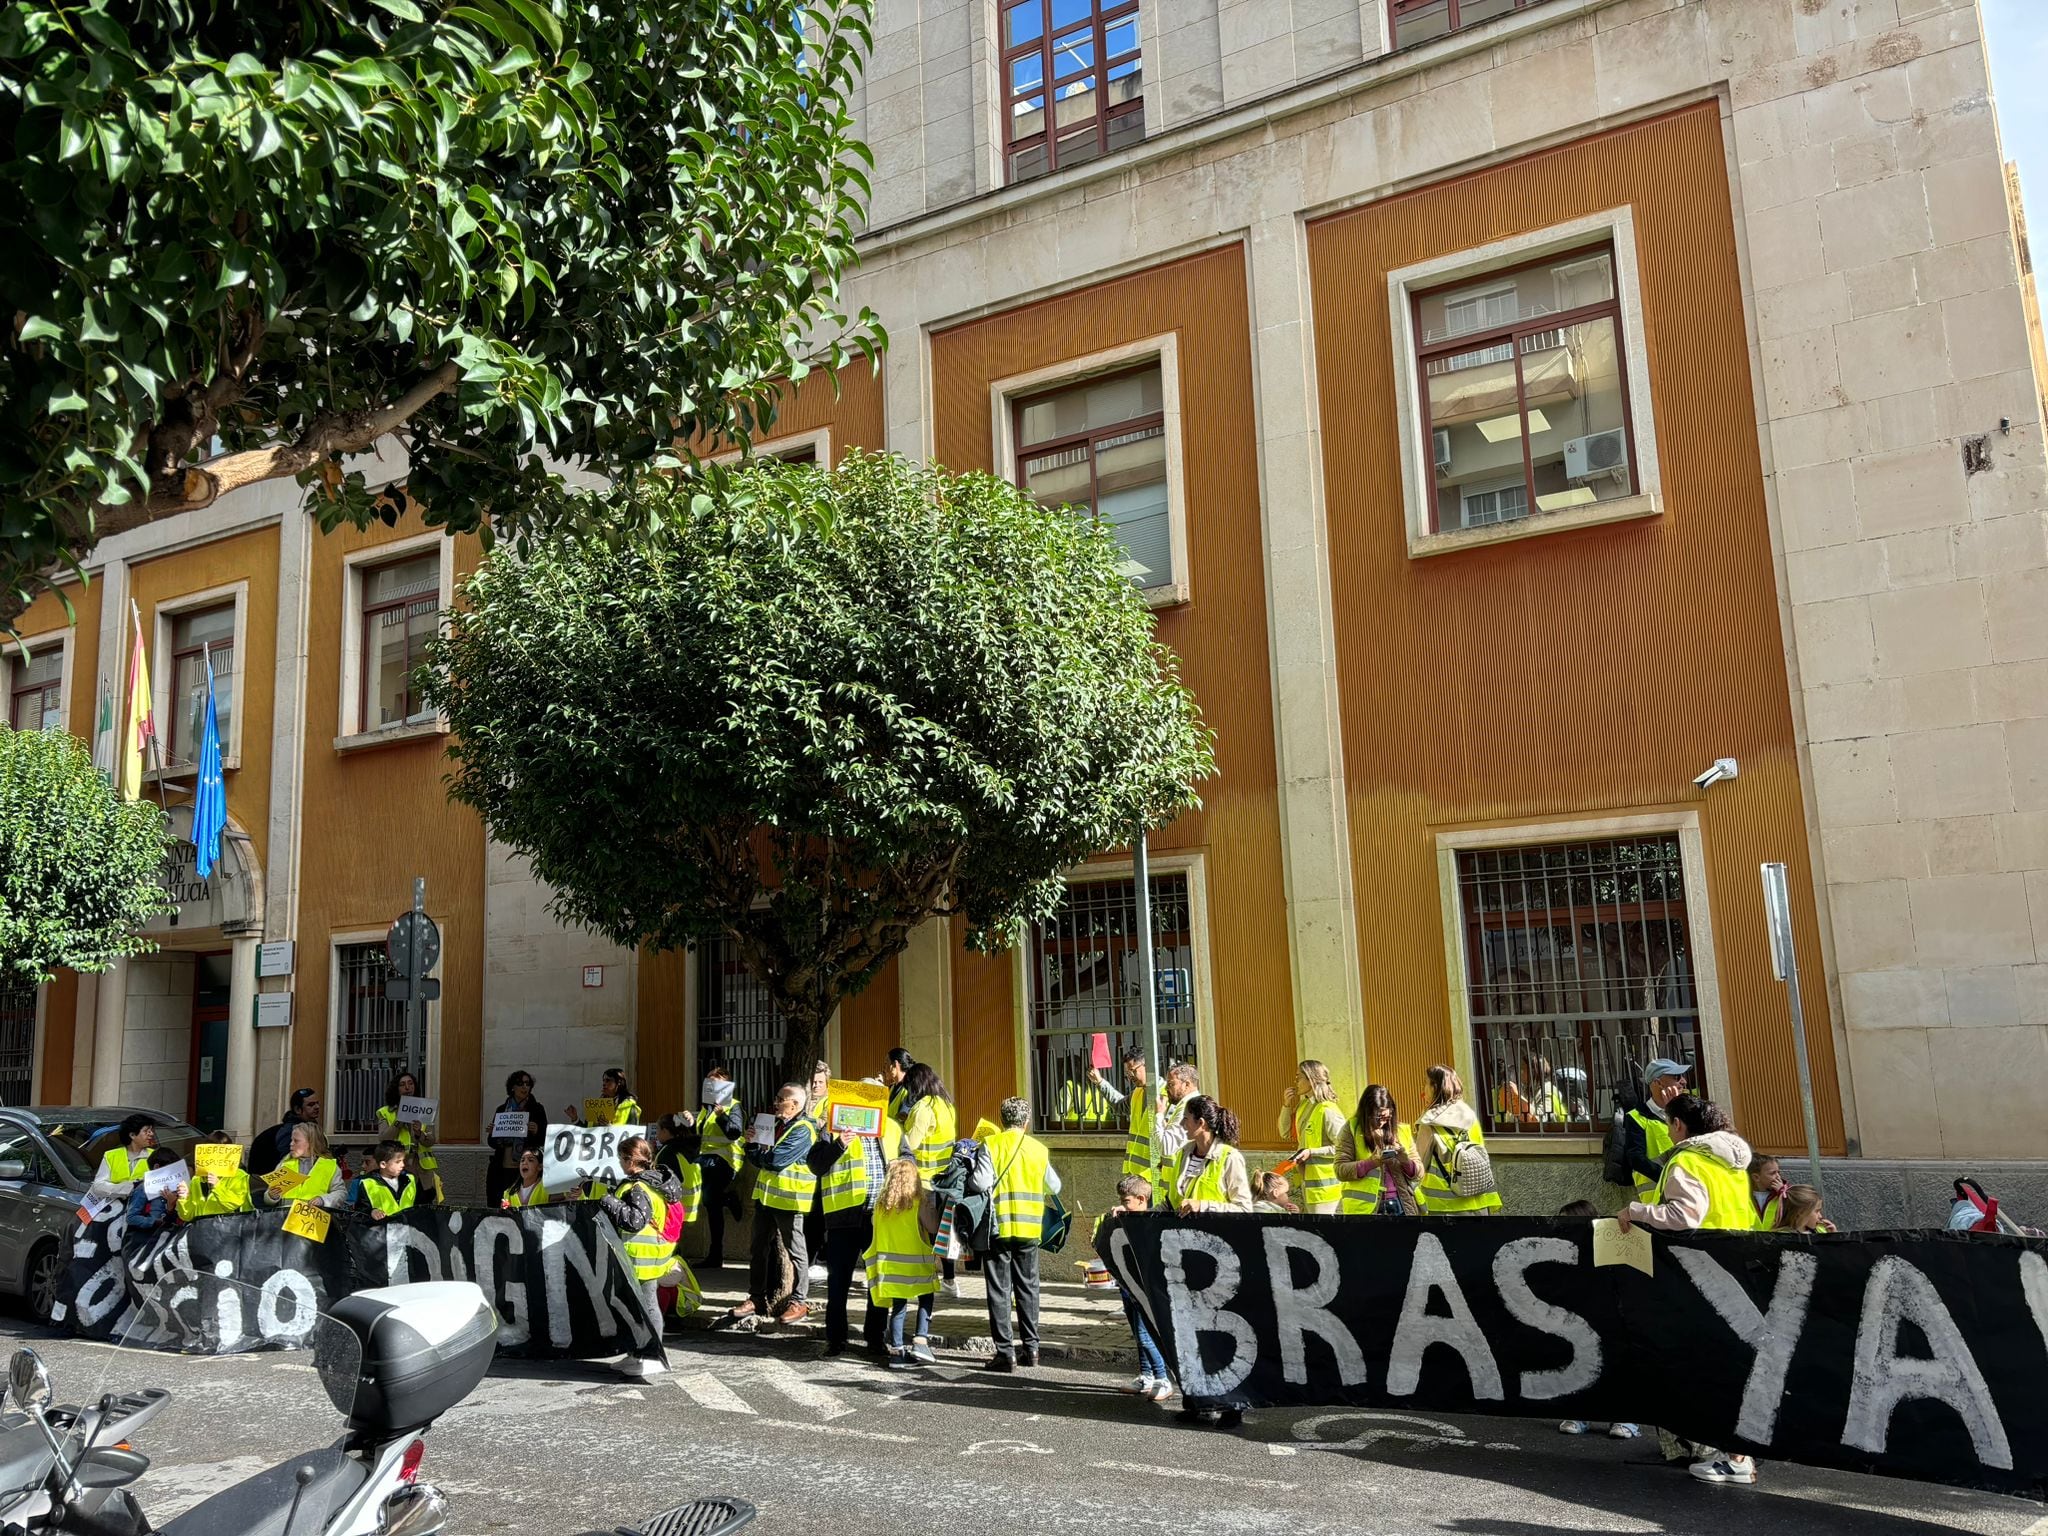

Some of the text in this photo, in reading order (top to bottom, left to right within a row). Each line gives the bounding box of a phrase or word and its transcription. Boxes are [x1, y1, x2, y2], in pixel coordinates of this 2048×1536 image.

[168, 865, 185, 885] DE
[401, 1104, 433, 1115] DIGNO
[584, 1099, 613, 1109] OBRAS
[196, 1146, 242, 1155] QUEREMOS
[554, 1130, 645, 1162] OBR
[293, 1203, 329, 1224] OBRAS
[301, 1219, 315, 1233] YA
